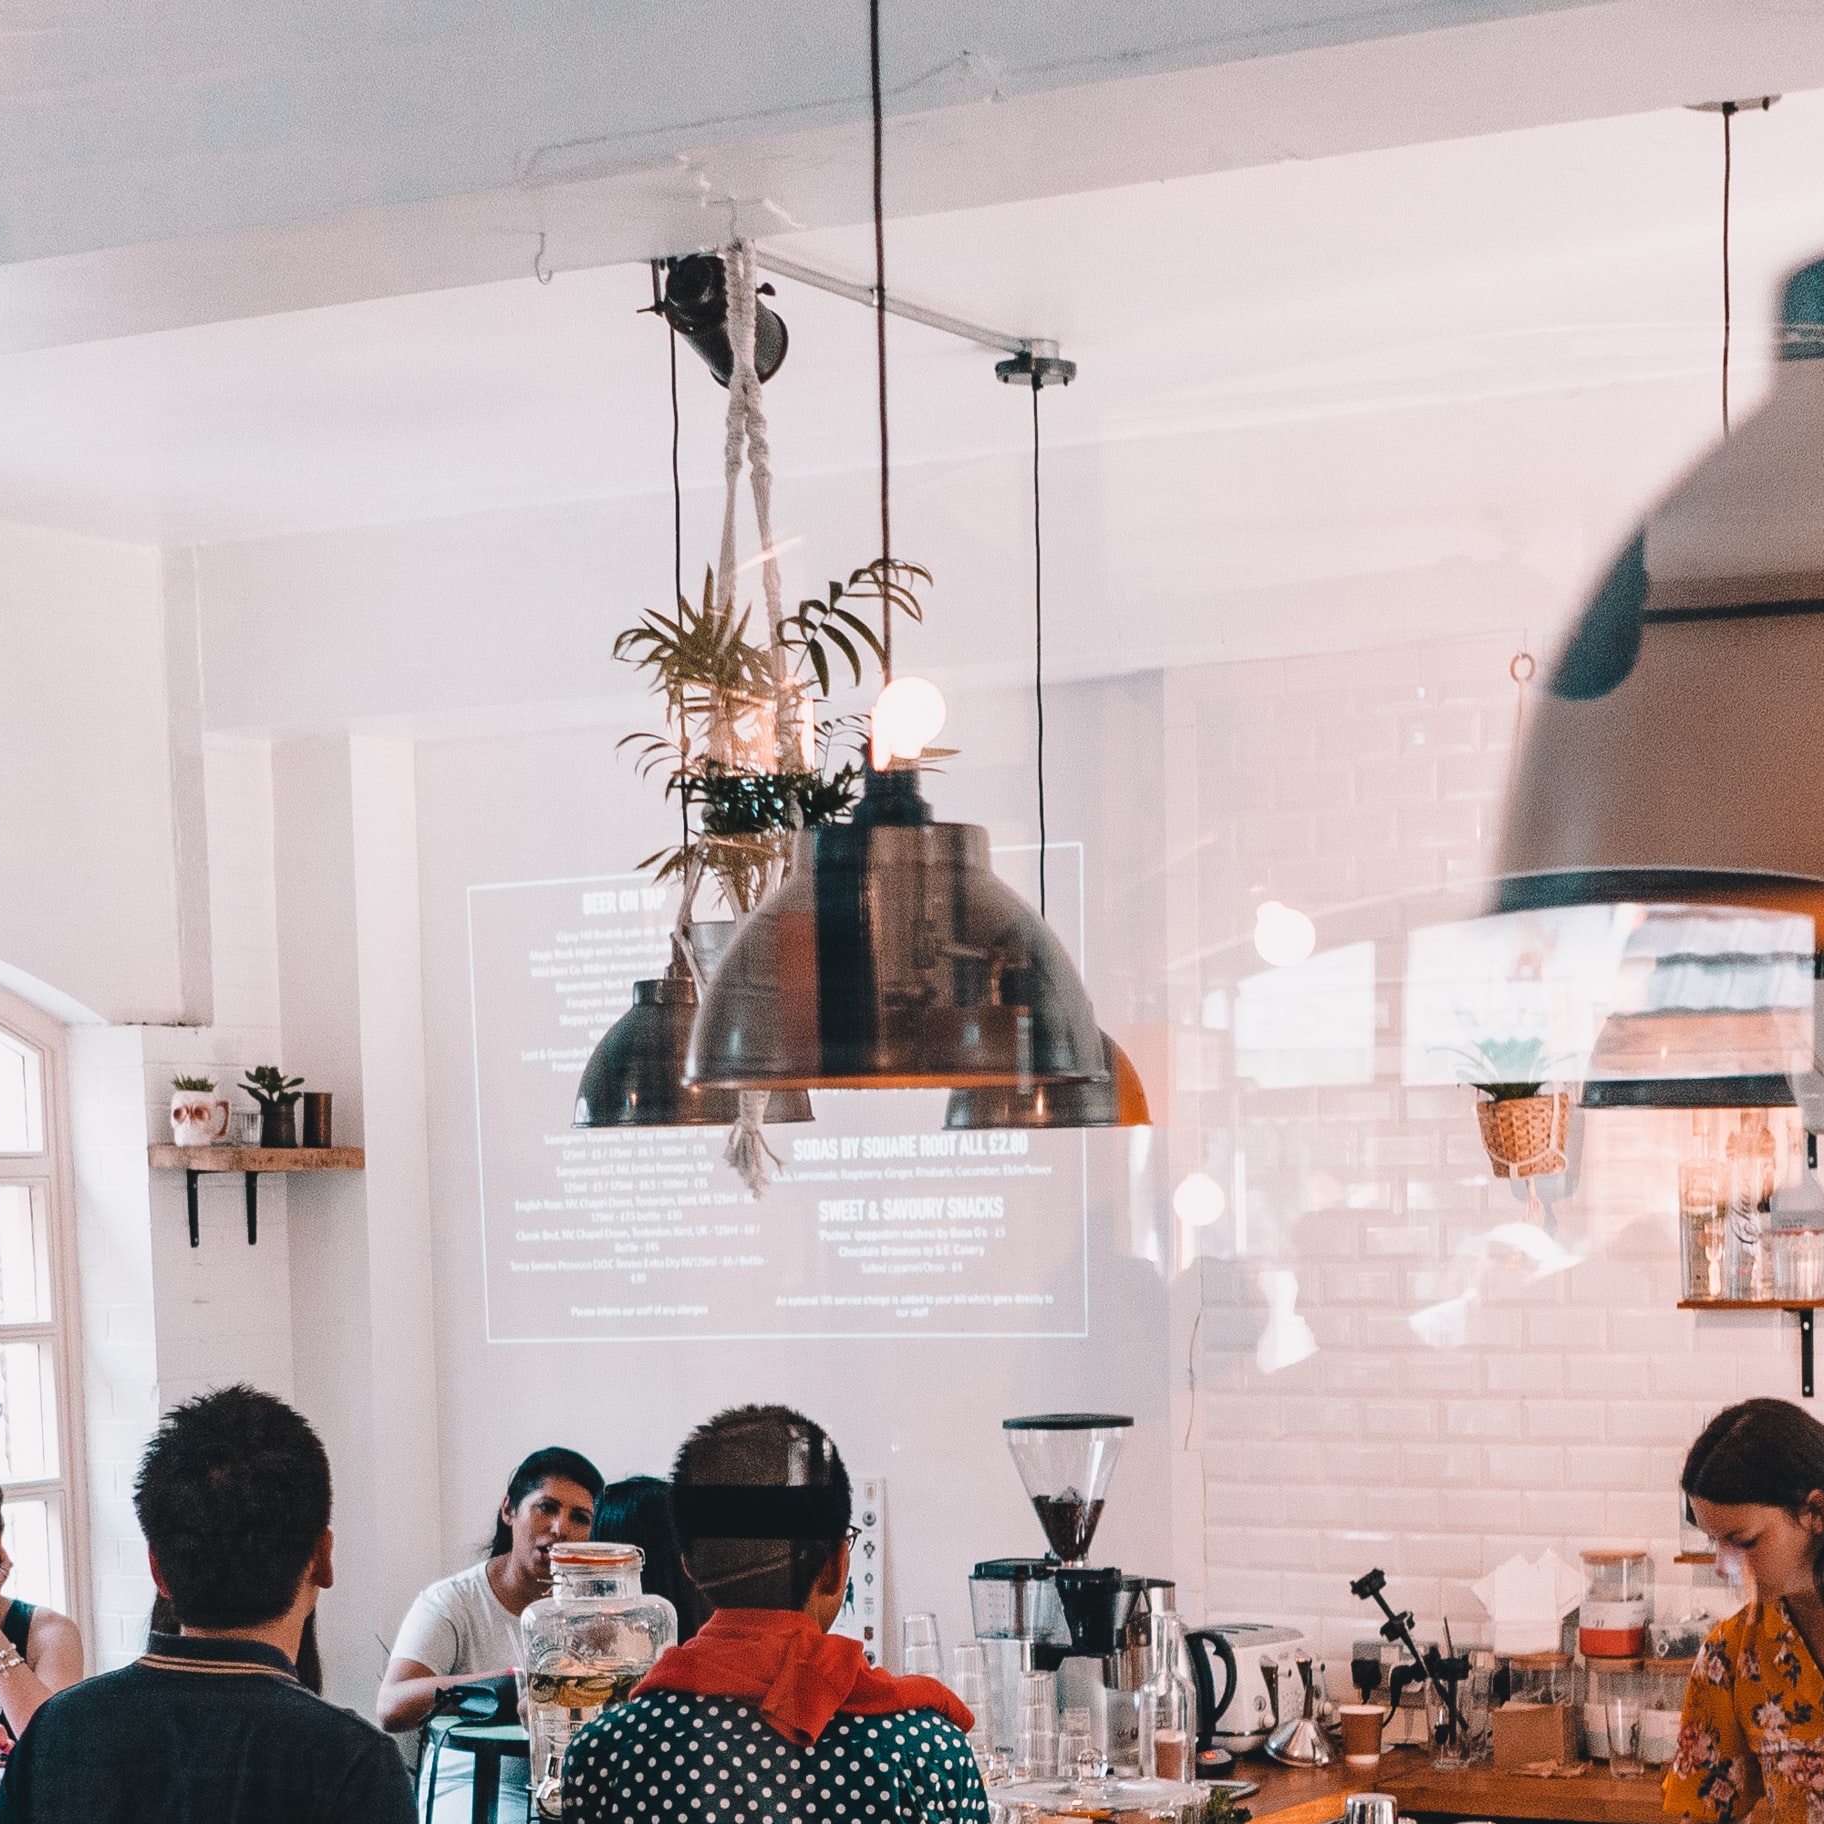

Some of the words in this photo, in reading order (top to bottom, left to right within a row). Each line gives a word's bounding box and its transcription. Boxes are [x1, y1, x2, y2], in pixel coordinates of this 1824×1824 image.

[582, 891, 617, 915] BEER
[619, 889, 639, 912] ON
[640, 887, 666, 911] TAP
[793, 1138, 838, 1161] SODAS
[841, 1136, 860, 1159] BY
[862, 1135, 917, 1159] SQUARE
[920, 1134, 957, 1158] ROOT
[959, 1133, 987, 1157] ALL
[818, 1199, 866, 1221] SWEET
[867, 1200, 880, 1220] &
[882, 1197, 945, 1220] SAVOURY
[946, 1196, 1004, 1219] SNACKS
